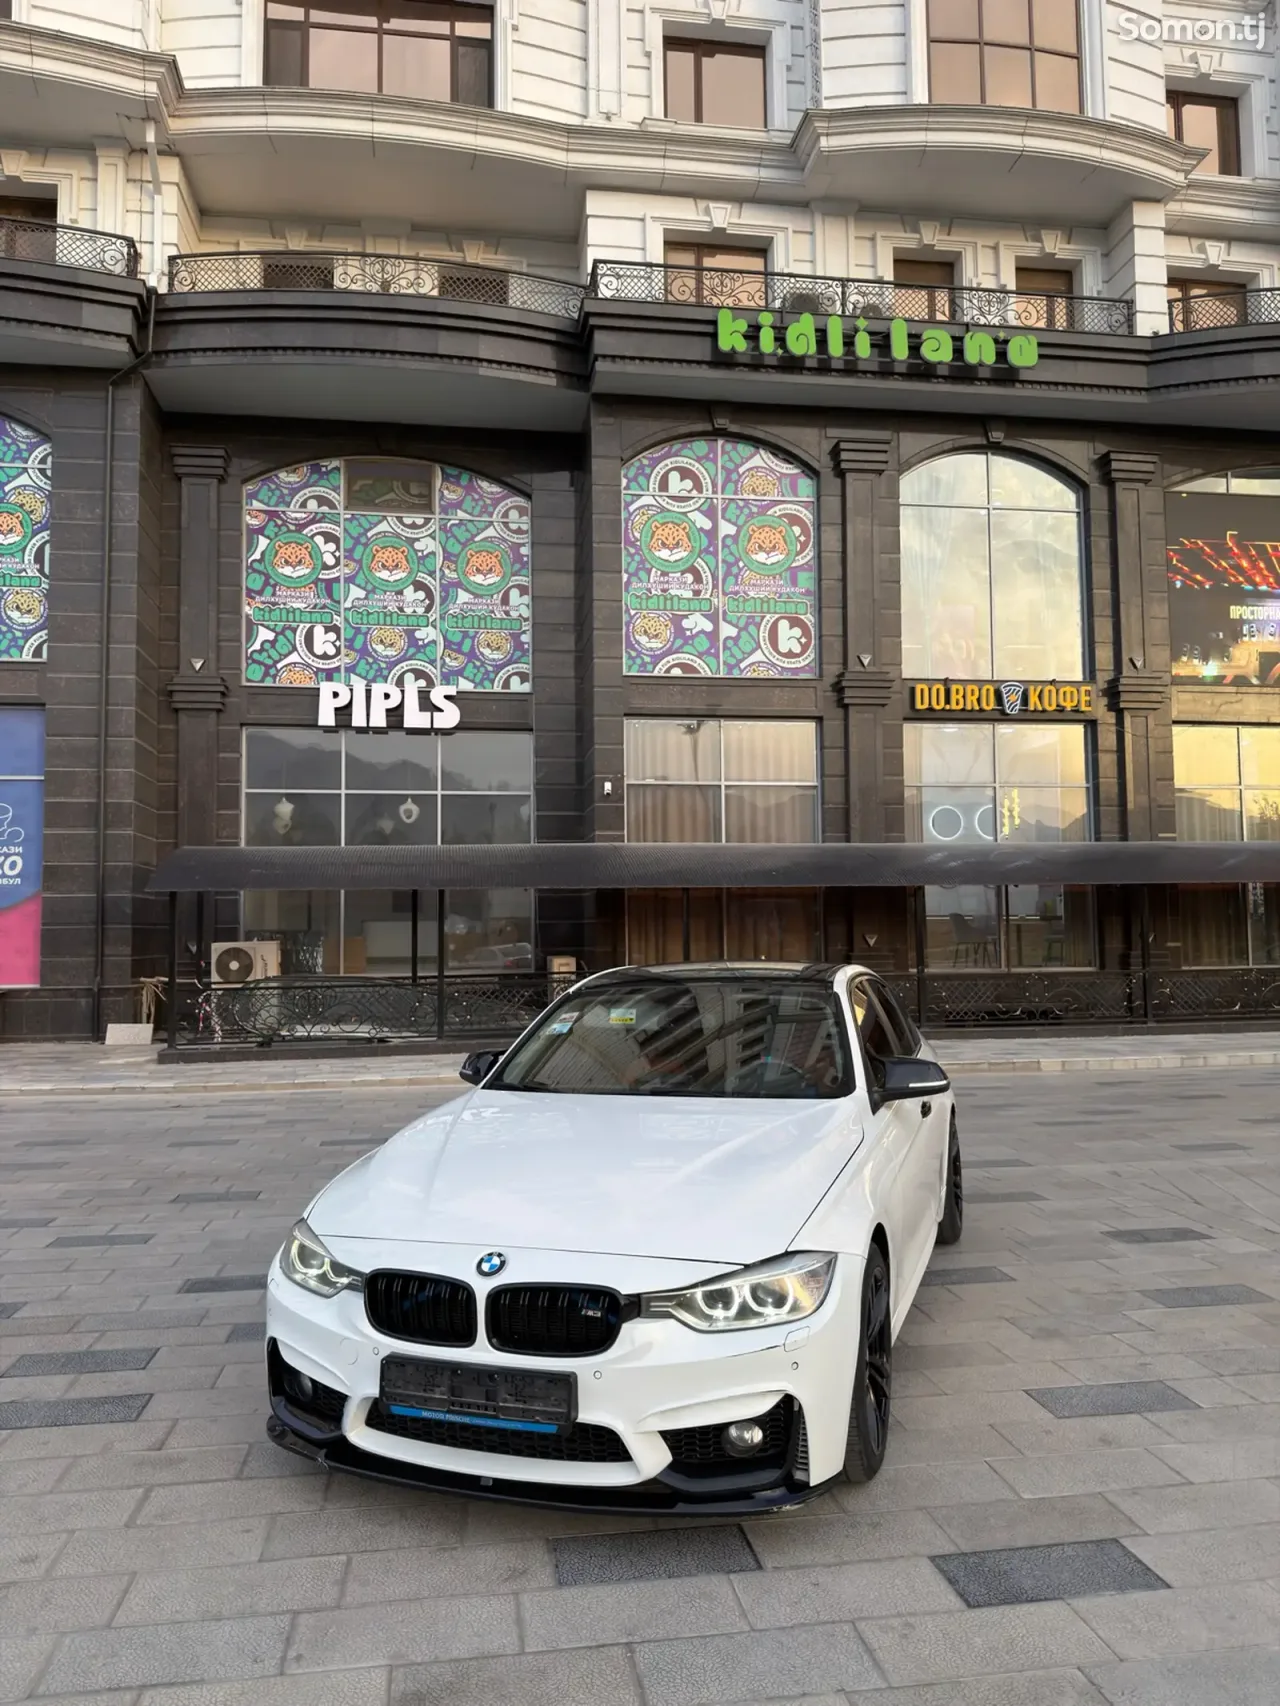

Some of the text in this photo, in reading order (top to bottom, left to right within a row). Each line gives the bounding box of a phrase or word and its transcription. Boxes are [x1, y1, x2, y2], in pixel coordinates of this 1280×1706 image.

[318, 682, 460, 729] PIPLS
[915, 684, 995, 710] DO.BRO
[1028, 685, 1092, 711] КОФЕ
